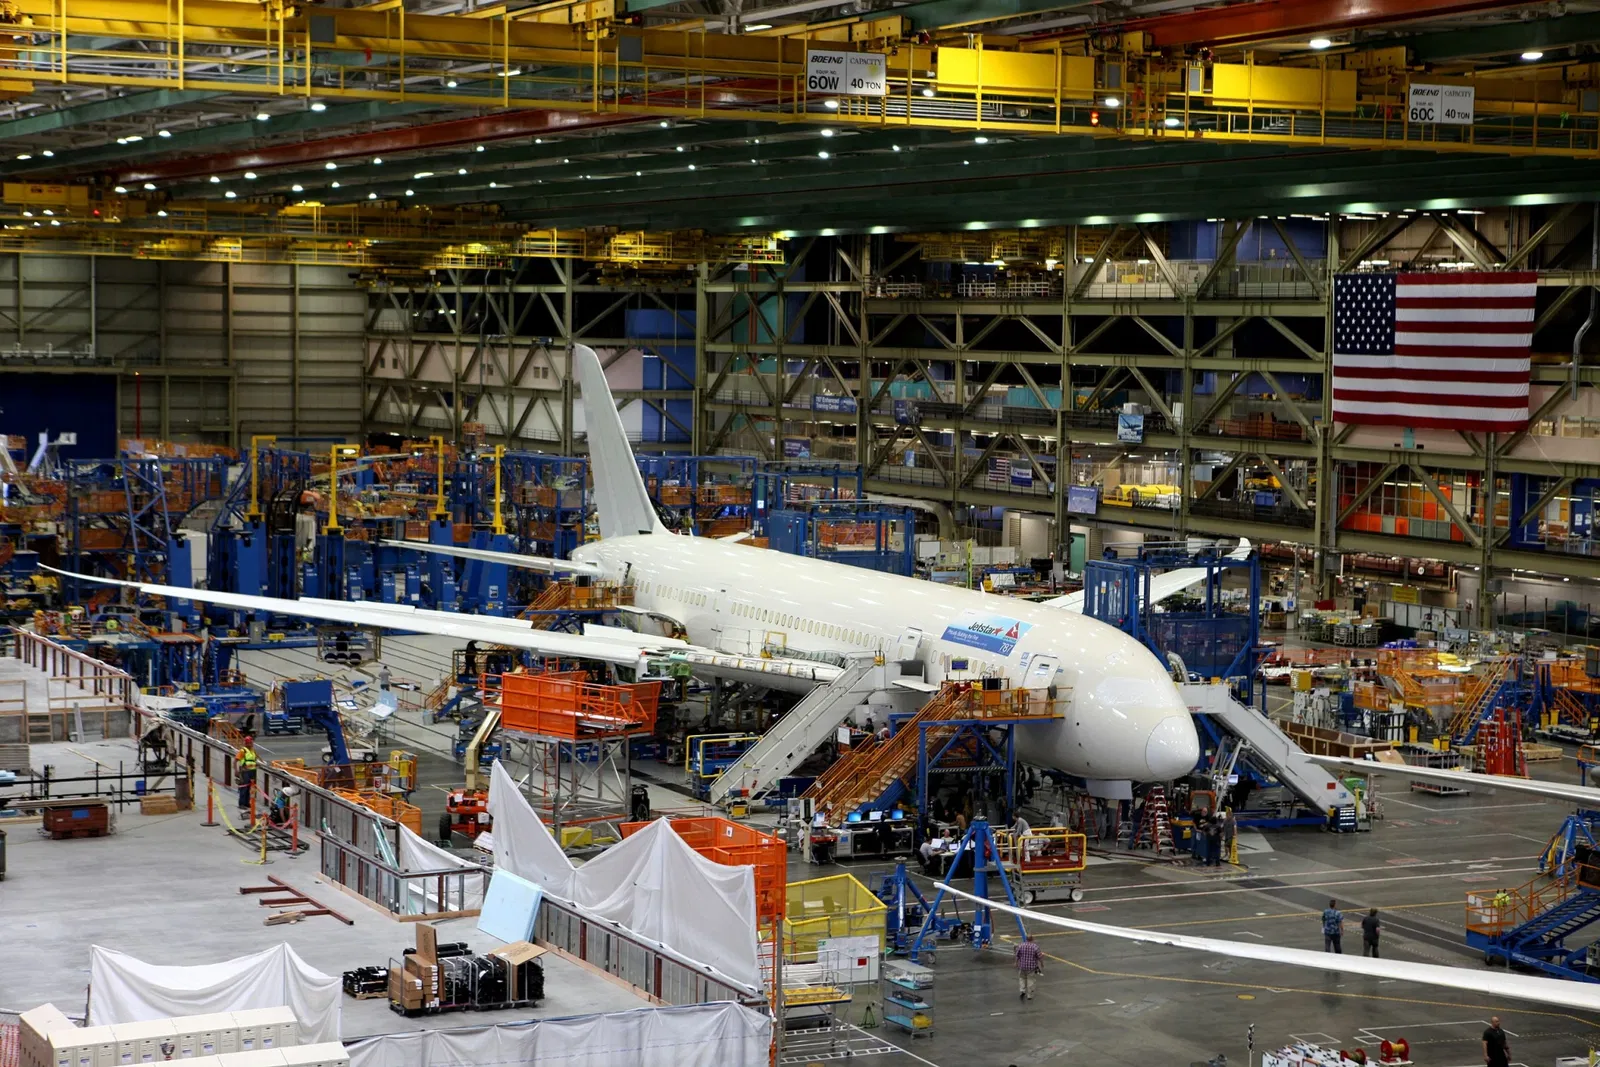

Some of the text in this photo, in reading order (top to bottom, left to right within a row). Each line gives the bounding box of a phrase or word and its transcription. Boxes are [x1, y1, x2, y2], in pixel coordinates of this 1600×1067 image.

[811, 55, 843, 64] BOEING
[850, 57, 882, 66] CAPACITY
[808, 75, 839, 90] 60W
[850, 78, 881, 89] 40 TON
[1412, 88, 1439, 96] BOEING
[1410, 107, 1434, 121] 60C
[1445, 108, 1456, 119] 40
[968, 621, 995, 635] Jetstar
[999, 642, 1014, 653] 787
